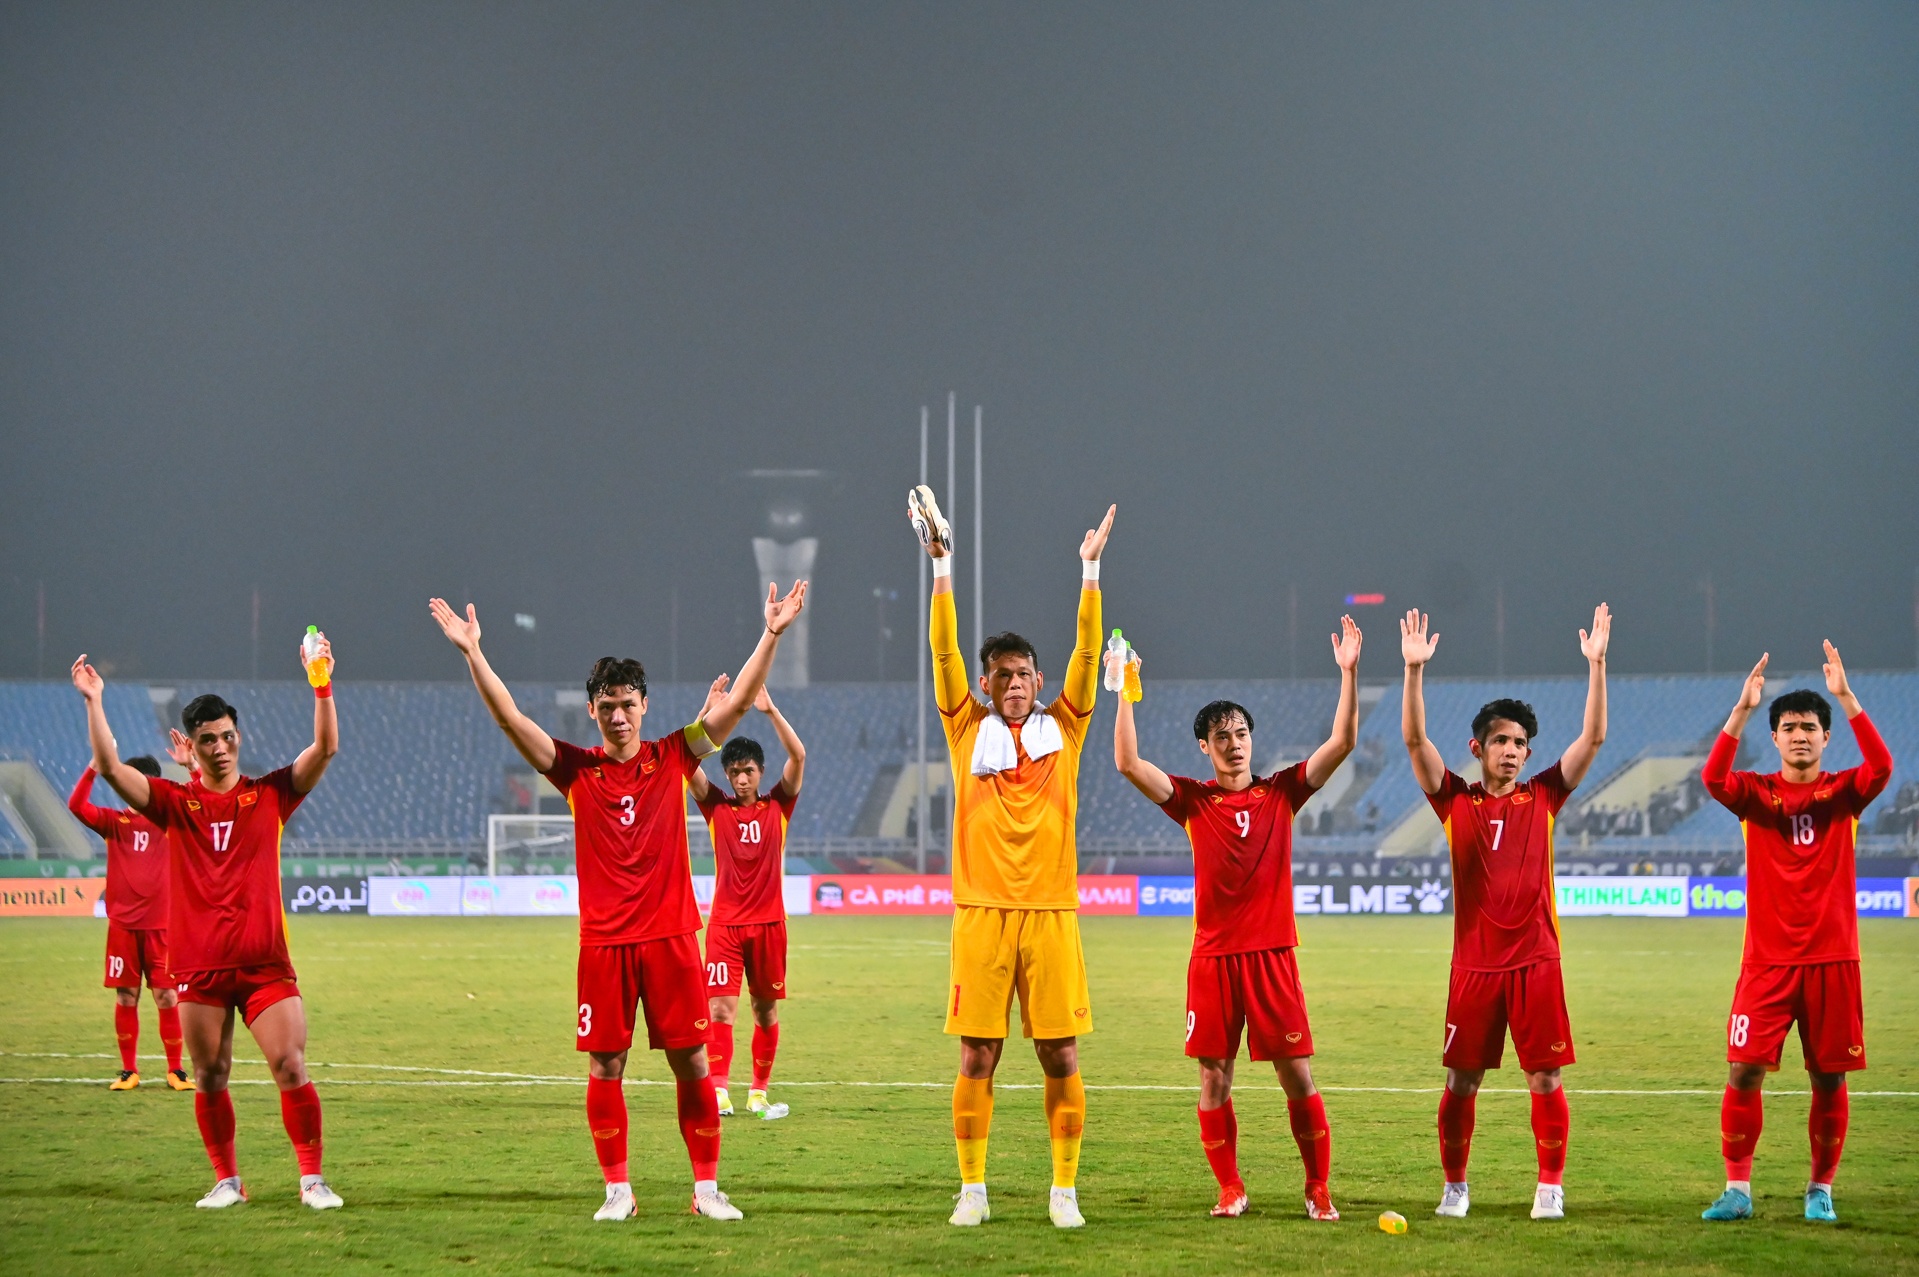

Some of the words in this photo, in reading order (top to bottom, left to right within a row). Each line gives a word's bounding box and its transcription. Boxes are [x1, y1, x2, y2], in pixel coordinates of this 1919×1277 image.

[620, 795, 635, 826] 3
[1235, 810, 1250, 838] 9
[133, 830, 149, 852] 19
[210, 820, 234, 851] 17
[738, 819, 761, 844] 20
[1489, 819, 1504, 851] 7
[1790, 814, 1814, 845] 18
[849, 885, 879, 905] CÀ
[1293, 885, 1413, 914] ELME
[1556, 887, 1682, 905] THINHLAND
[109, 955, 124, 978] 19
[706, 961, 729, 987] 20
[953, 985, 961, 1016] 1
[577, 1003, 592, 1037] 3
[1185, 1009, 1196, 1042] 9
[1729, 1013, 1750, 1047] 18
[1443, 1022, 1457, 1054] 7
